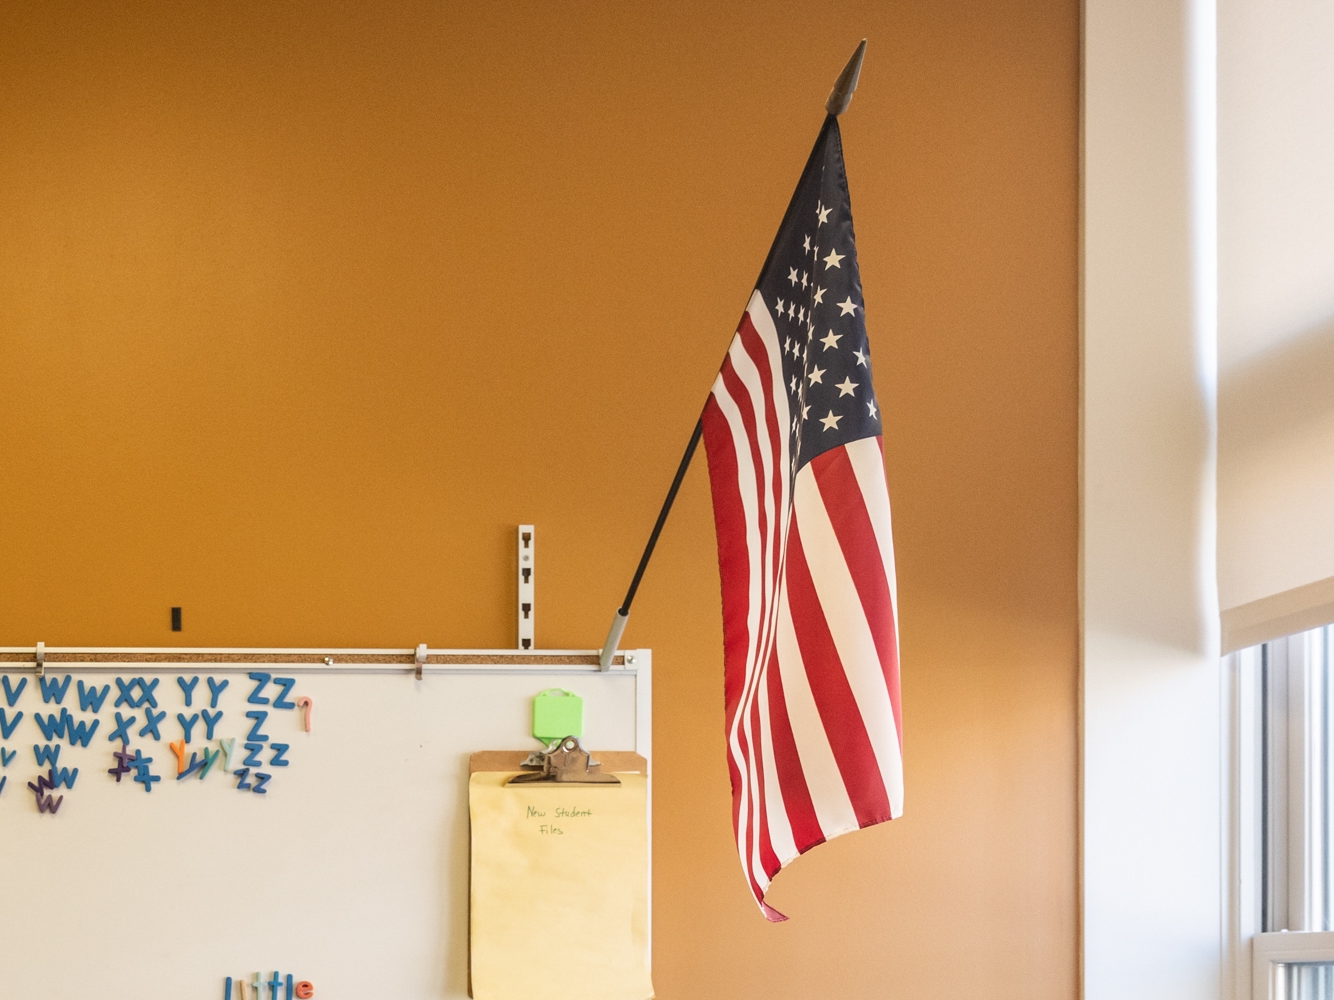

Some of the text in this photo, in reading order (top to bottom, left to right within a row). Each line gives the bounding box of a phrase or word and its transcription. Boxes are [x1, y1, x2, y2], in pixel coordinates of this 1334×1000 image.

[527, 806, 593, 818] New Student
[539, 824, 564, 835] Files
